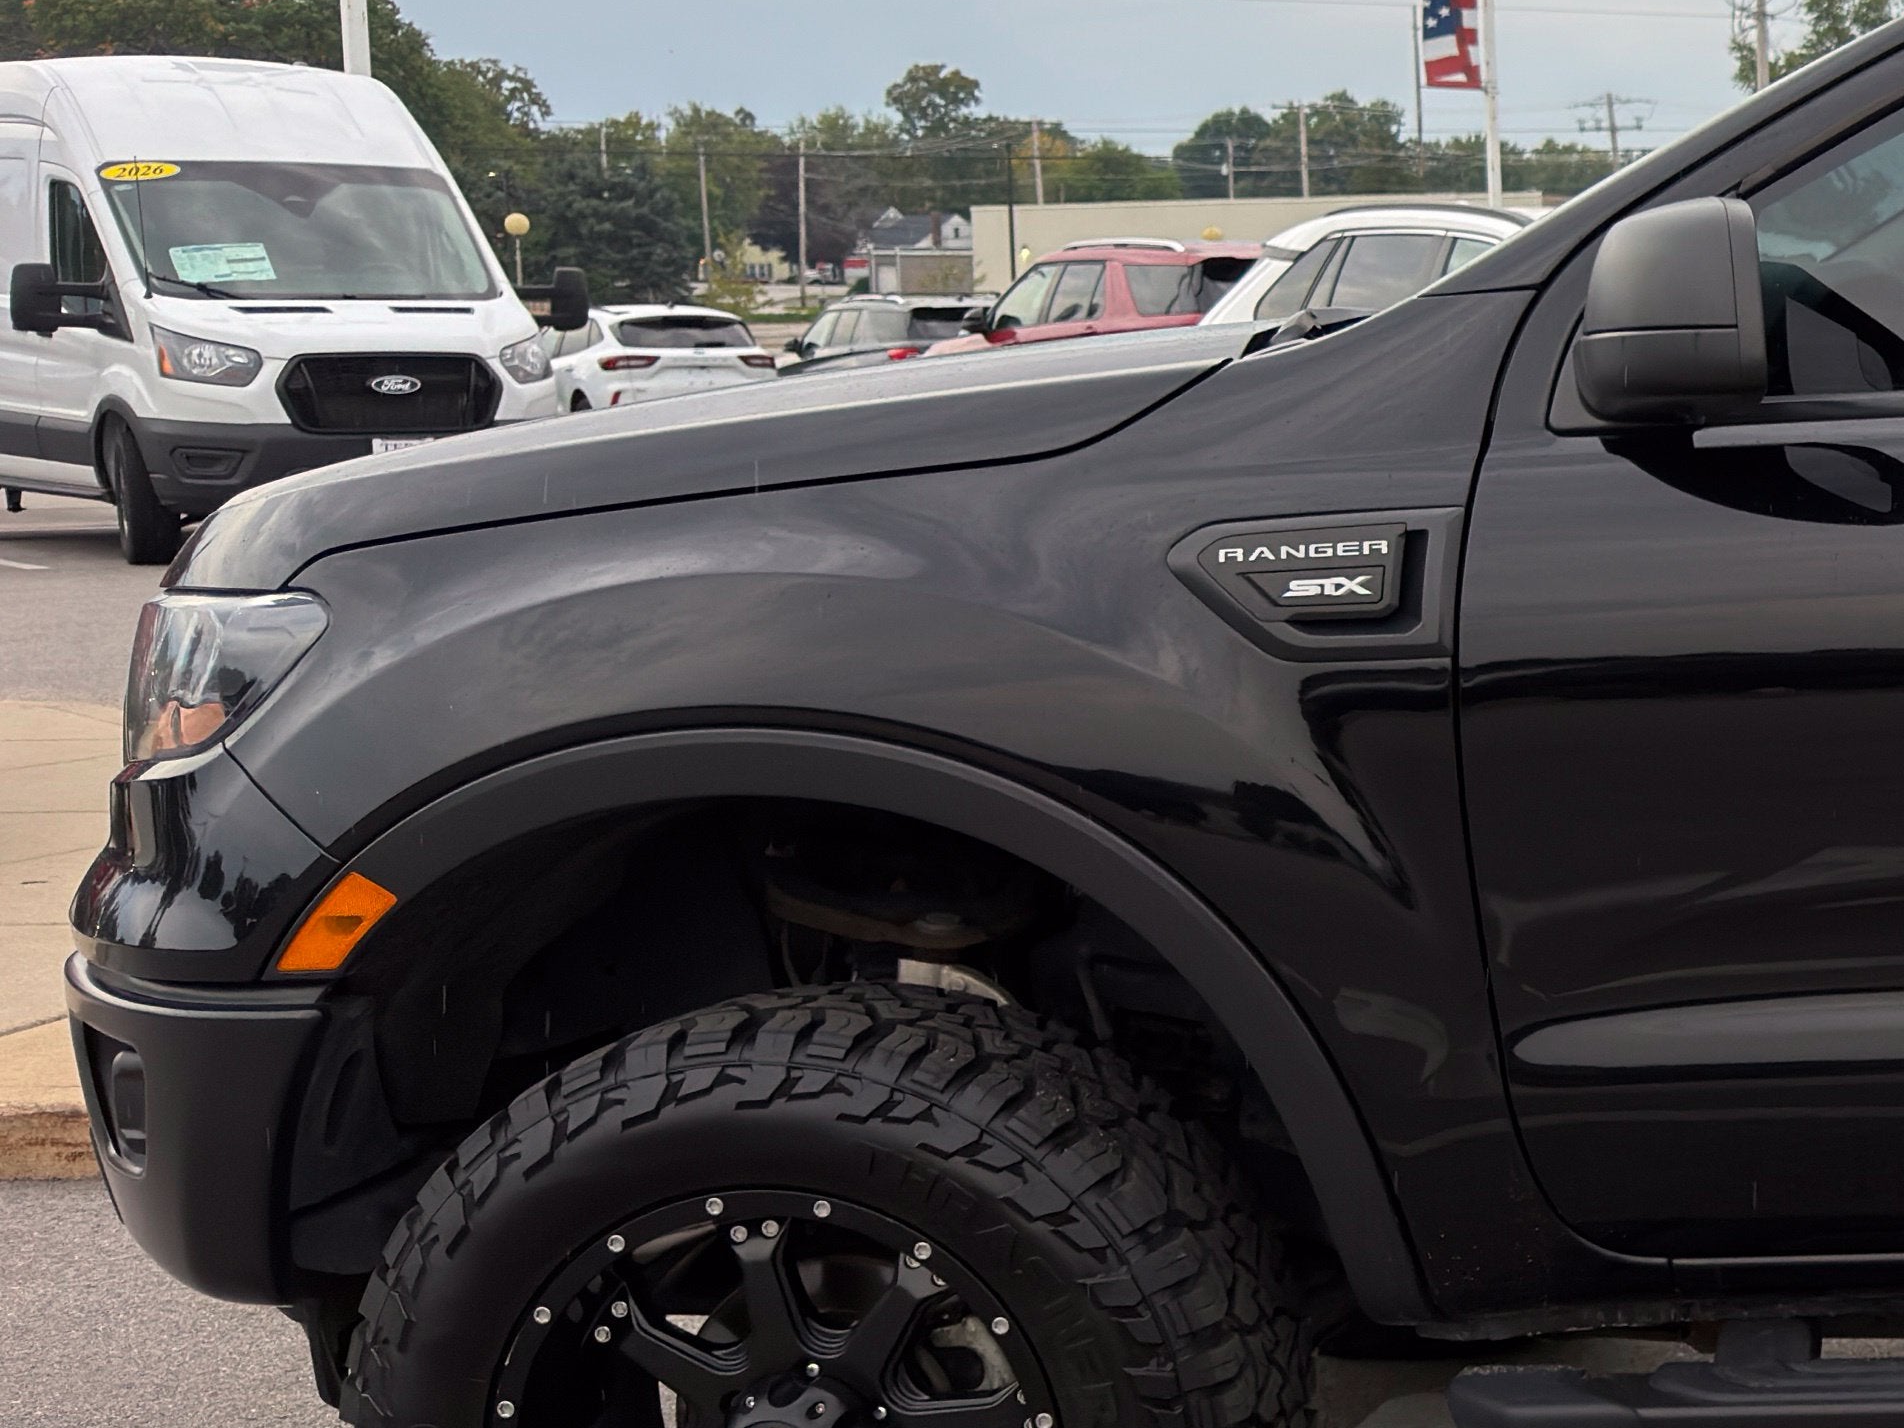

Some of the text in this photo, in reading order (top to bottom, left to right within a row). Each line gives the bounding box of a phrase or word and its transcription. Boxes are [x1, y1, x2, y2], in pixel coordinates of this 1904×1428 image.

[115, 165, 165, 179] 2026
[381, 378, 412, 391] Ford
[1217, 539, 1389, 563] RANGER
[1281, 574, 1374, 598] STX
